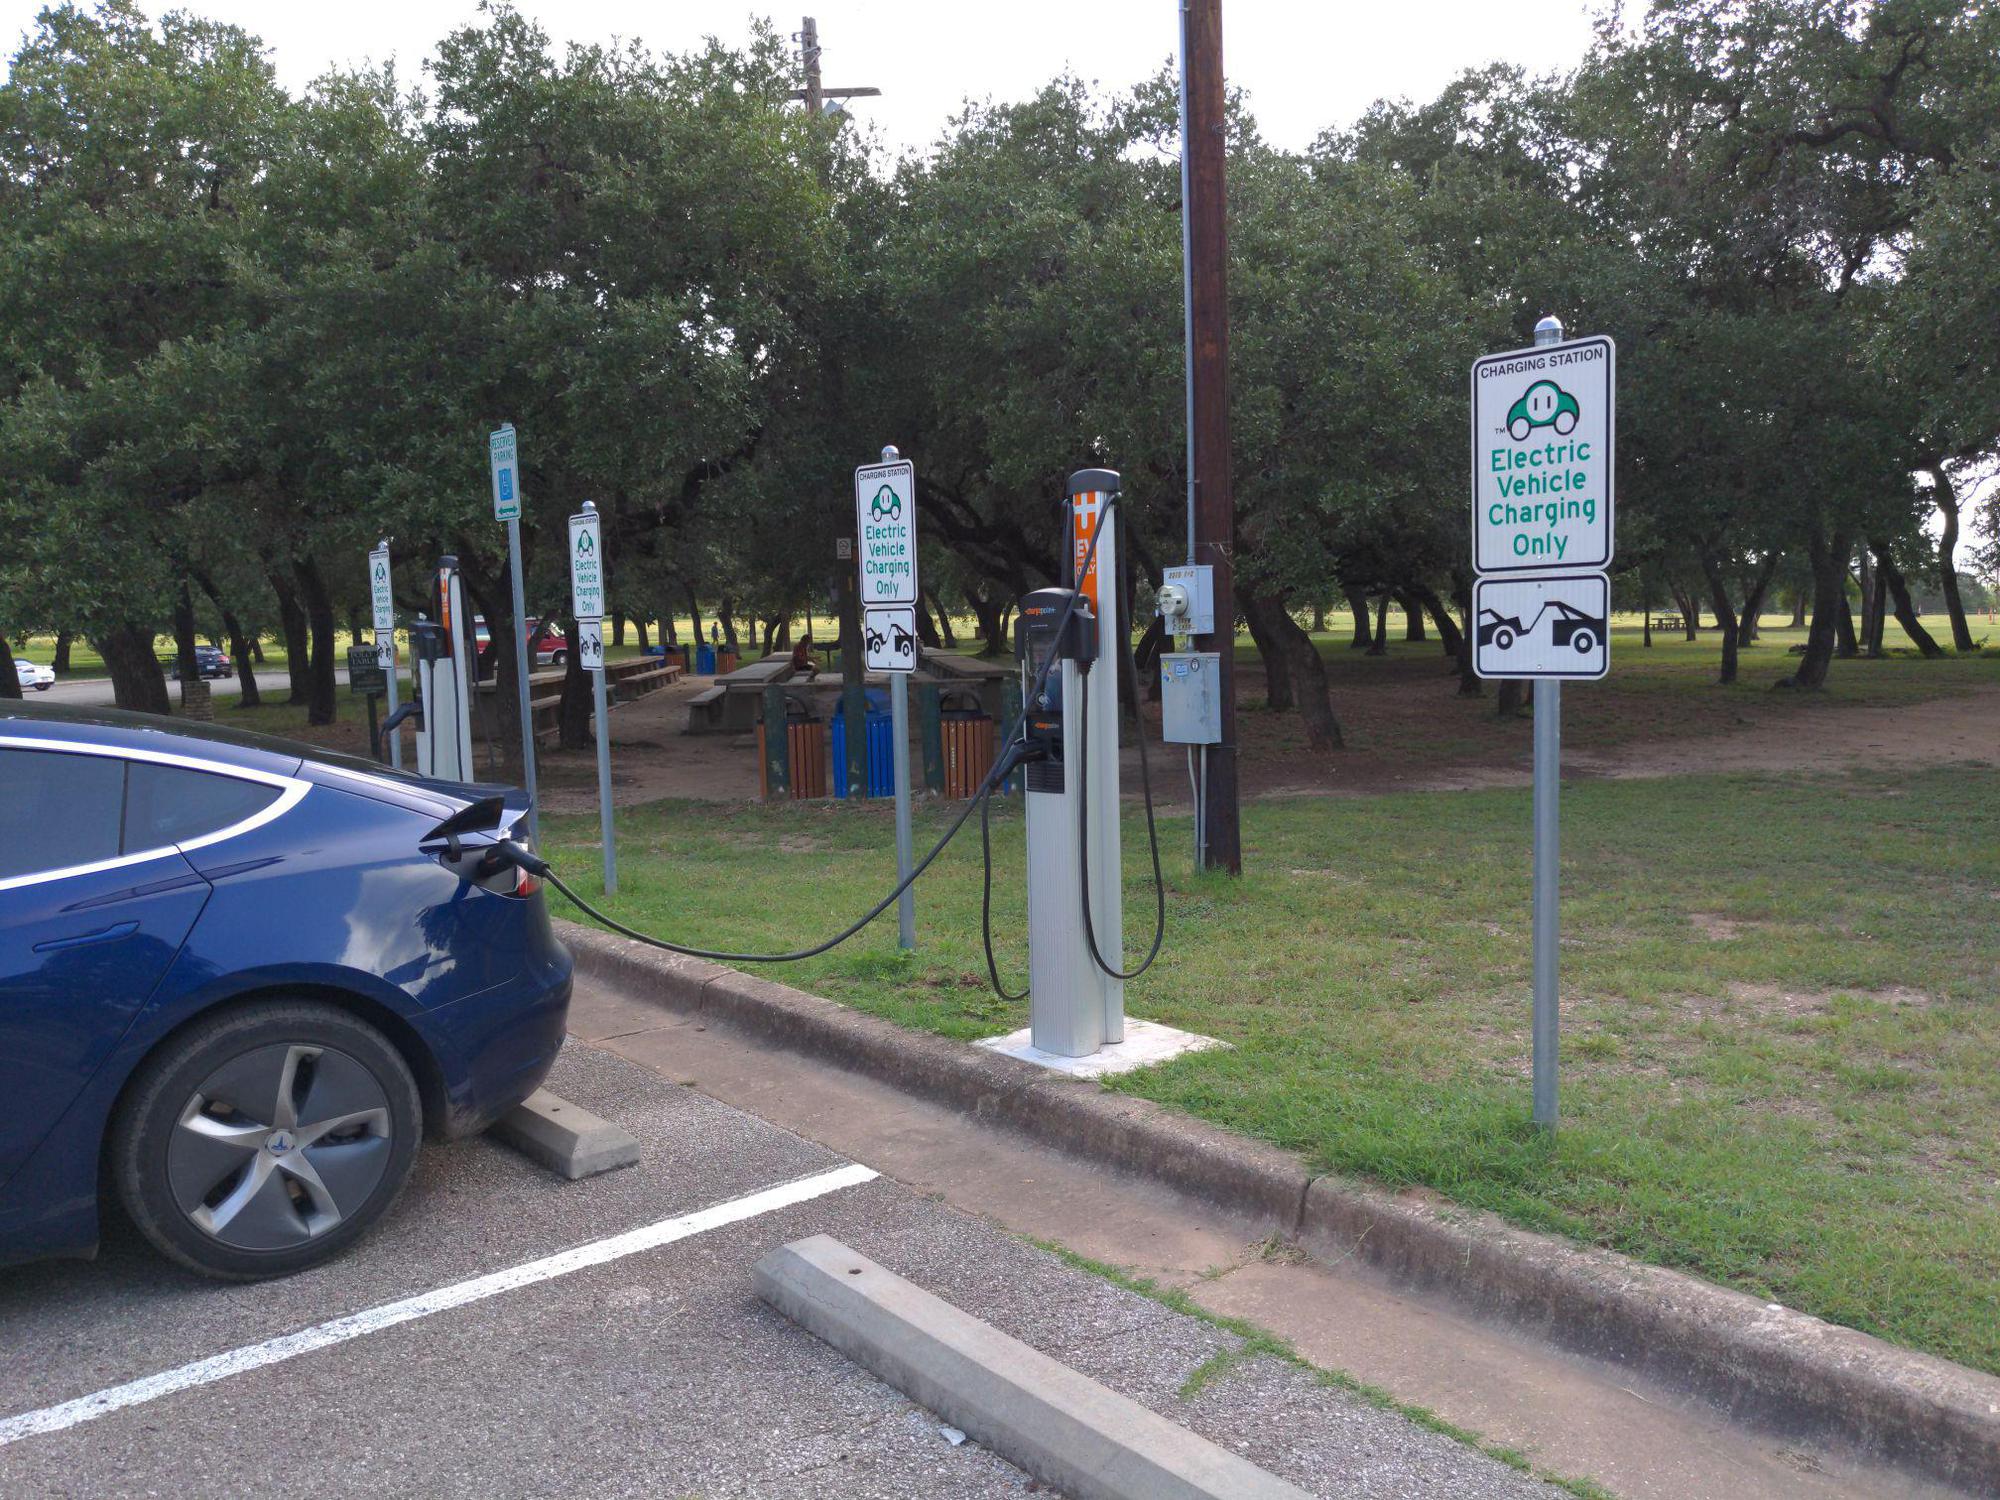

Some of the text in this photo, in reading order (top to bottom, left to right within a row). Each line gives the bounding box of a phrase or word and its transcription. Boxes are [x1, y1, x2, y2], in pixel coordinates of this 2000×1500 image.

[1481, 347, 1603, 379] CHARGING STATION
[1495, 427, 1506, 435] TM
[1491, 439, 1591, 472] Electric
[860, 467, 909, 481] CHARGING STATION
[1497, 468, 1586, 498] Vehicle
[1488, 497, 1596, 528] Charging
[866, 523, 907, 540] Electric
[868, 542, 905, 557] Vehicle
[1513, 532, 1568, 560] Only
[866, 559, 910, 578] Charging
[1076, 564, 1096, 576] OLY
[876, 580, 899, 599] Only
